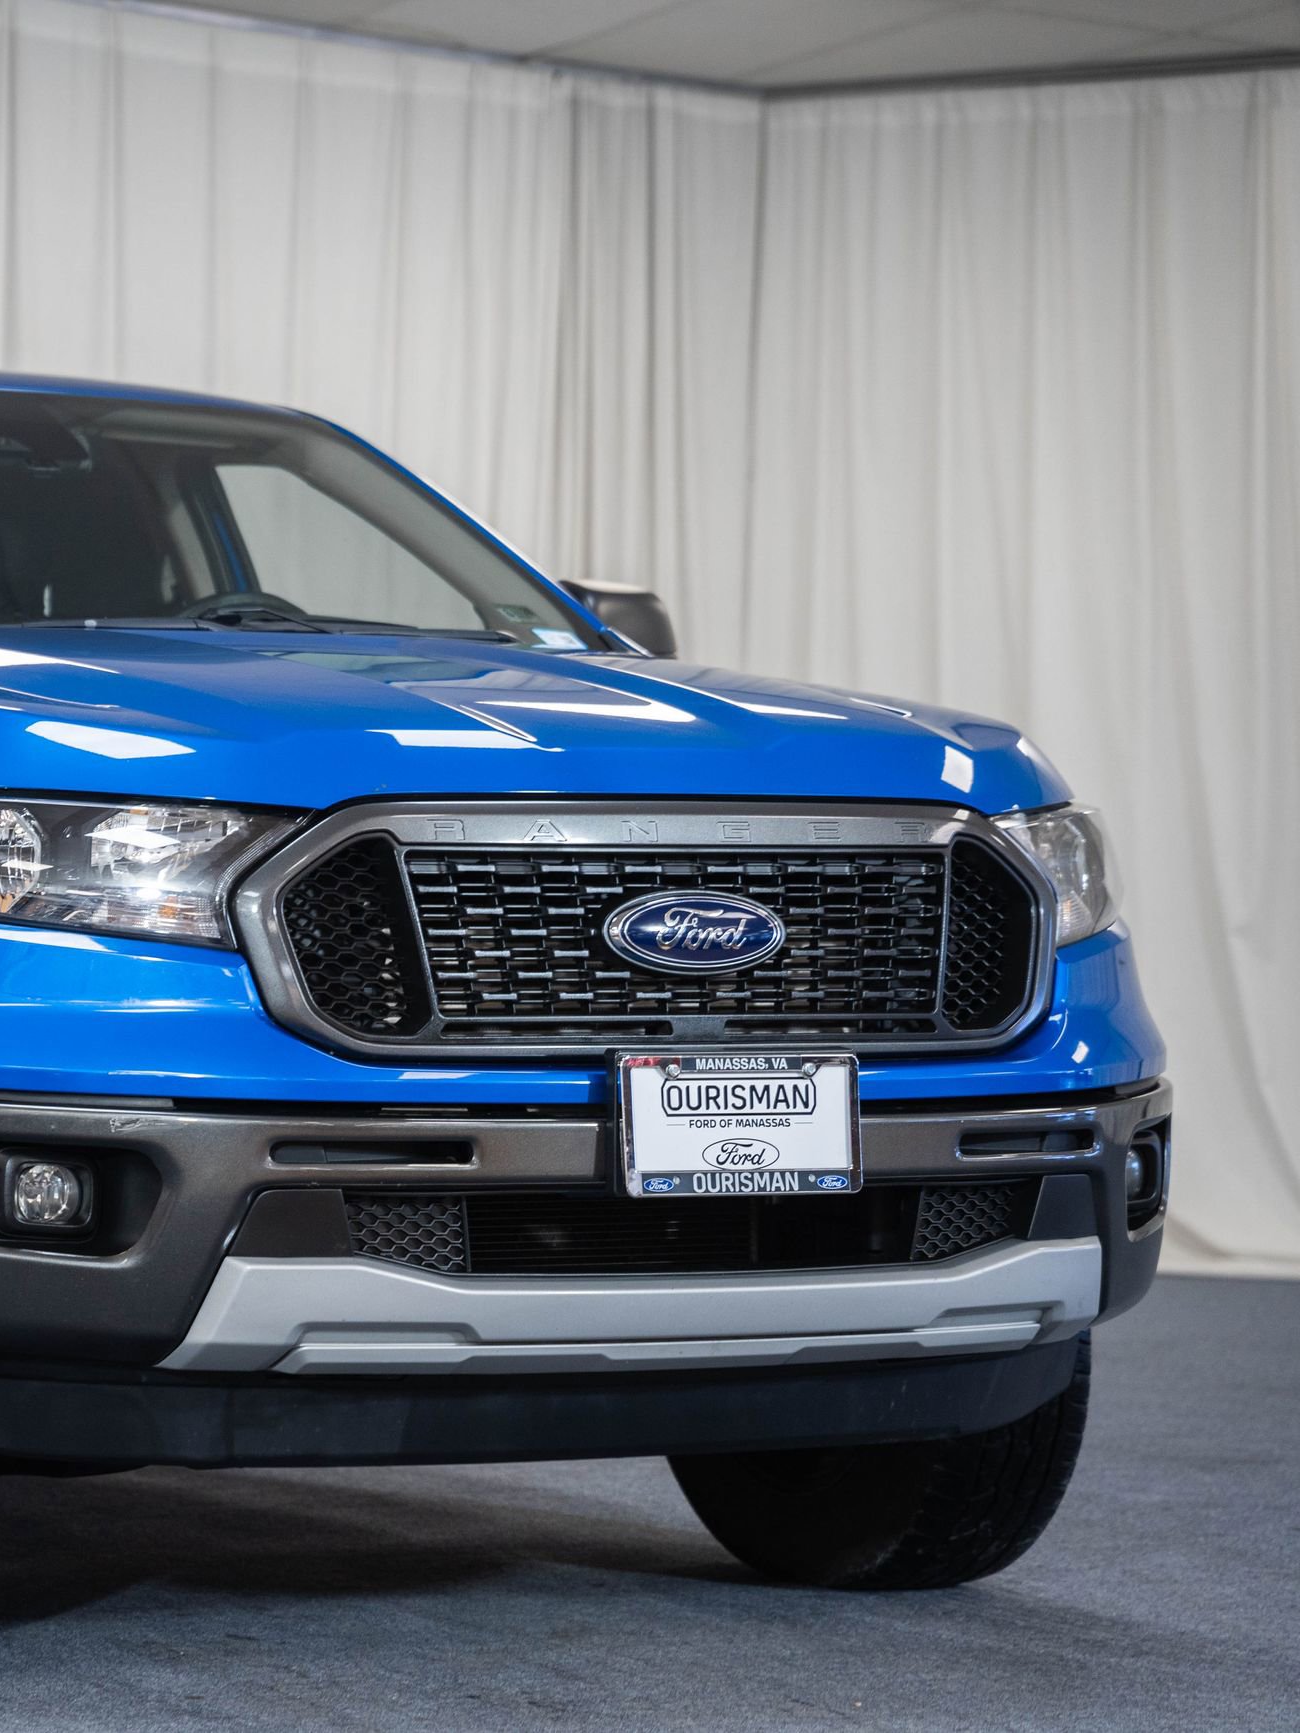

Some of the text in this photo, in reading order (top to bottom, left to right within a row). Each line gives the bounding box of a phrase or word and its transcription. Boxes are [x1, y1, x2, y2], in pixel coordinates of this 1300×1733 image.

[426, 817, 929, 843] RANGER
[655, 906, 748, 950] Ford
[695, 1057, 789, 1071] MANASSAS, VA
[665, 1084, 810, 1111] OURISMAN
[688, 1117, 792, 1129] FORD OF MANASSAS
[715, 1141, 766, 1166] Ford
[648, 1179, 670, 1192] Ford
[692, 1171, 799, 1193] OURISMAN
[821, 1176, 844, 1188] Ford
